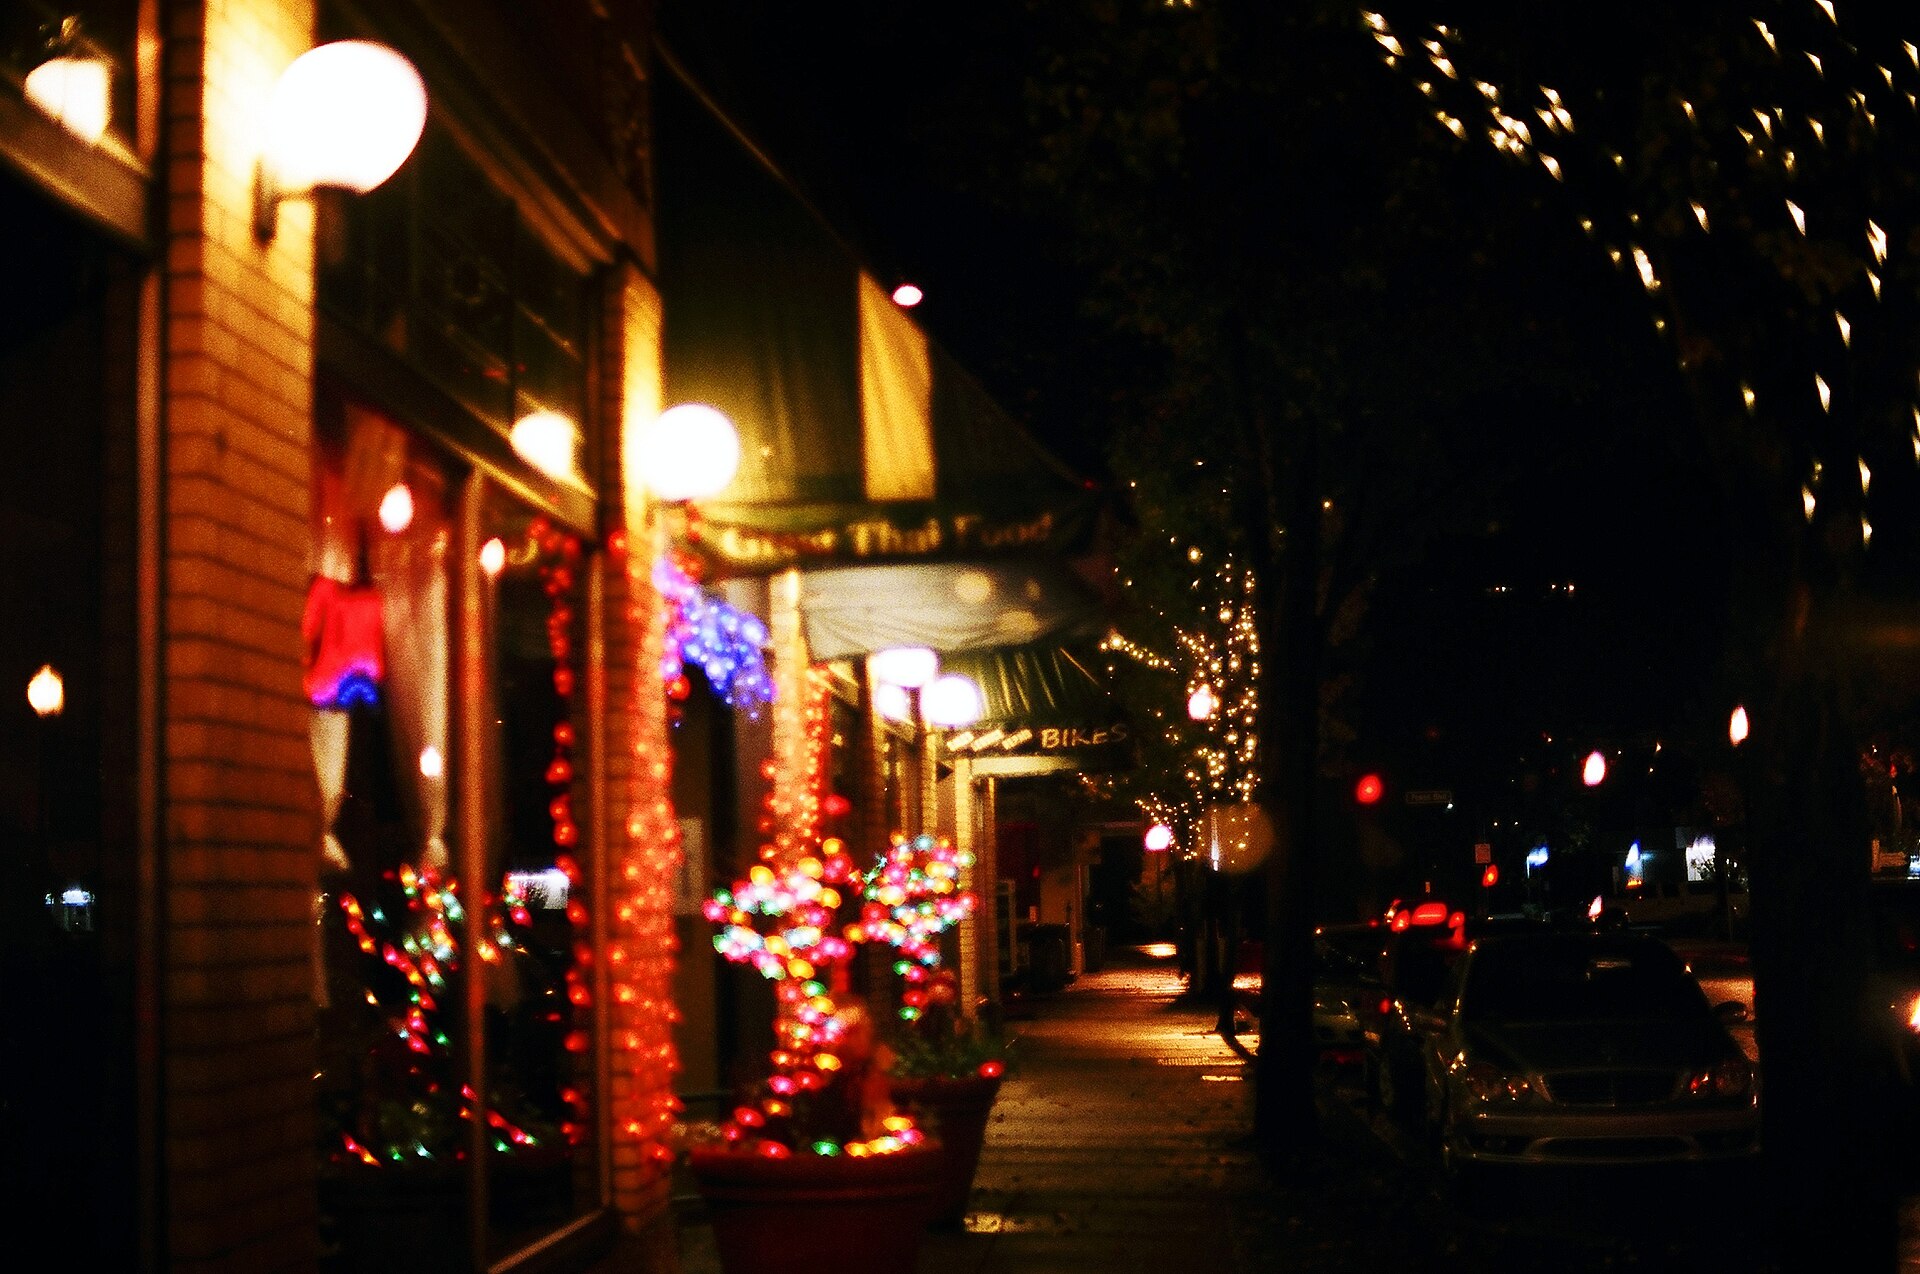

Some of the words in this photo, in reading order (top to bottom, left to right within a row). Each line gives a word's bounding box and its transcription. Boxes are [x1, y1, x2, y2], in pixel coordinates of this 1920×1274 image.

[846, 517, 943, 556] Thai
[953, 512, 1054, 548] Food
[1041, 722, 1128, 749] BIKES
